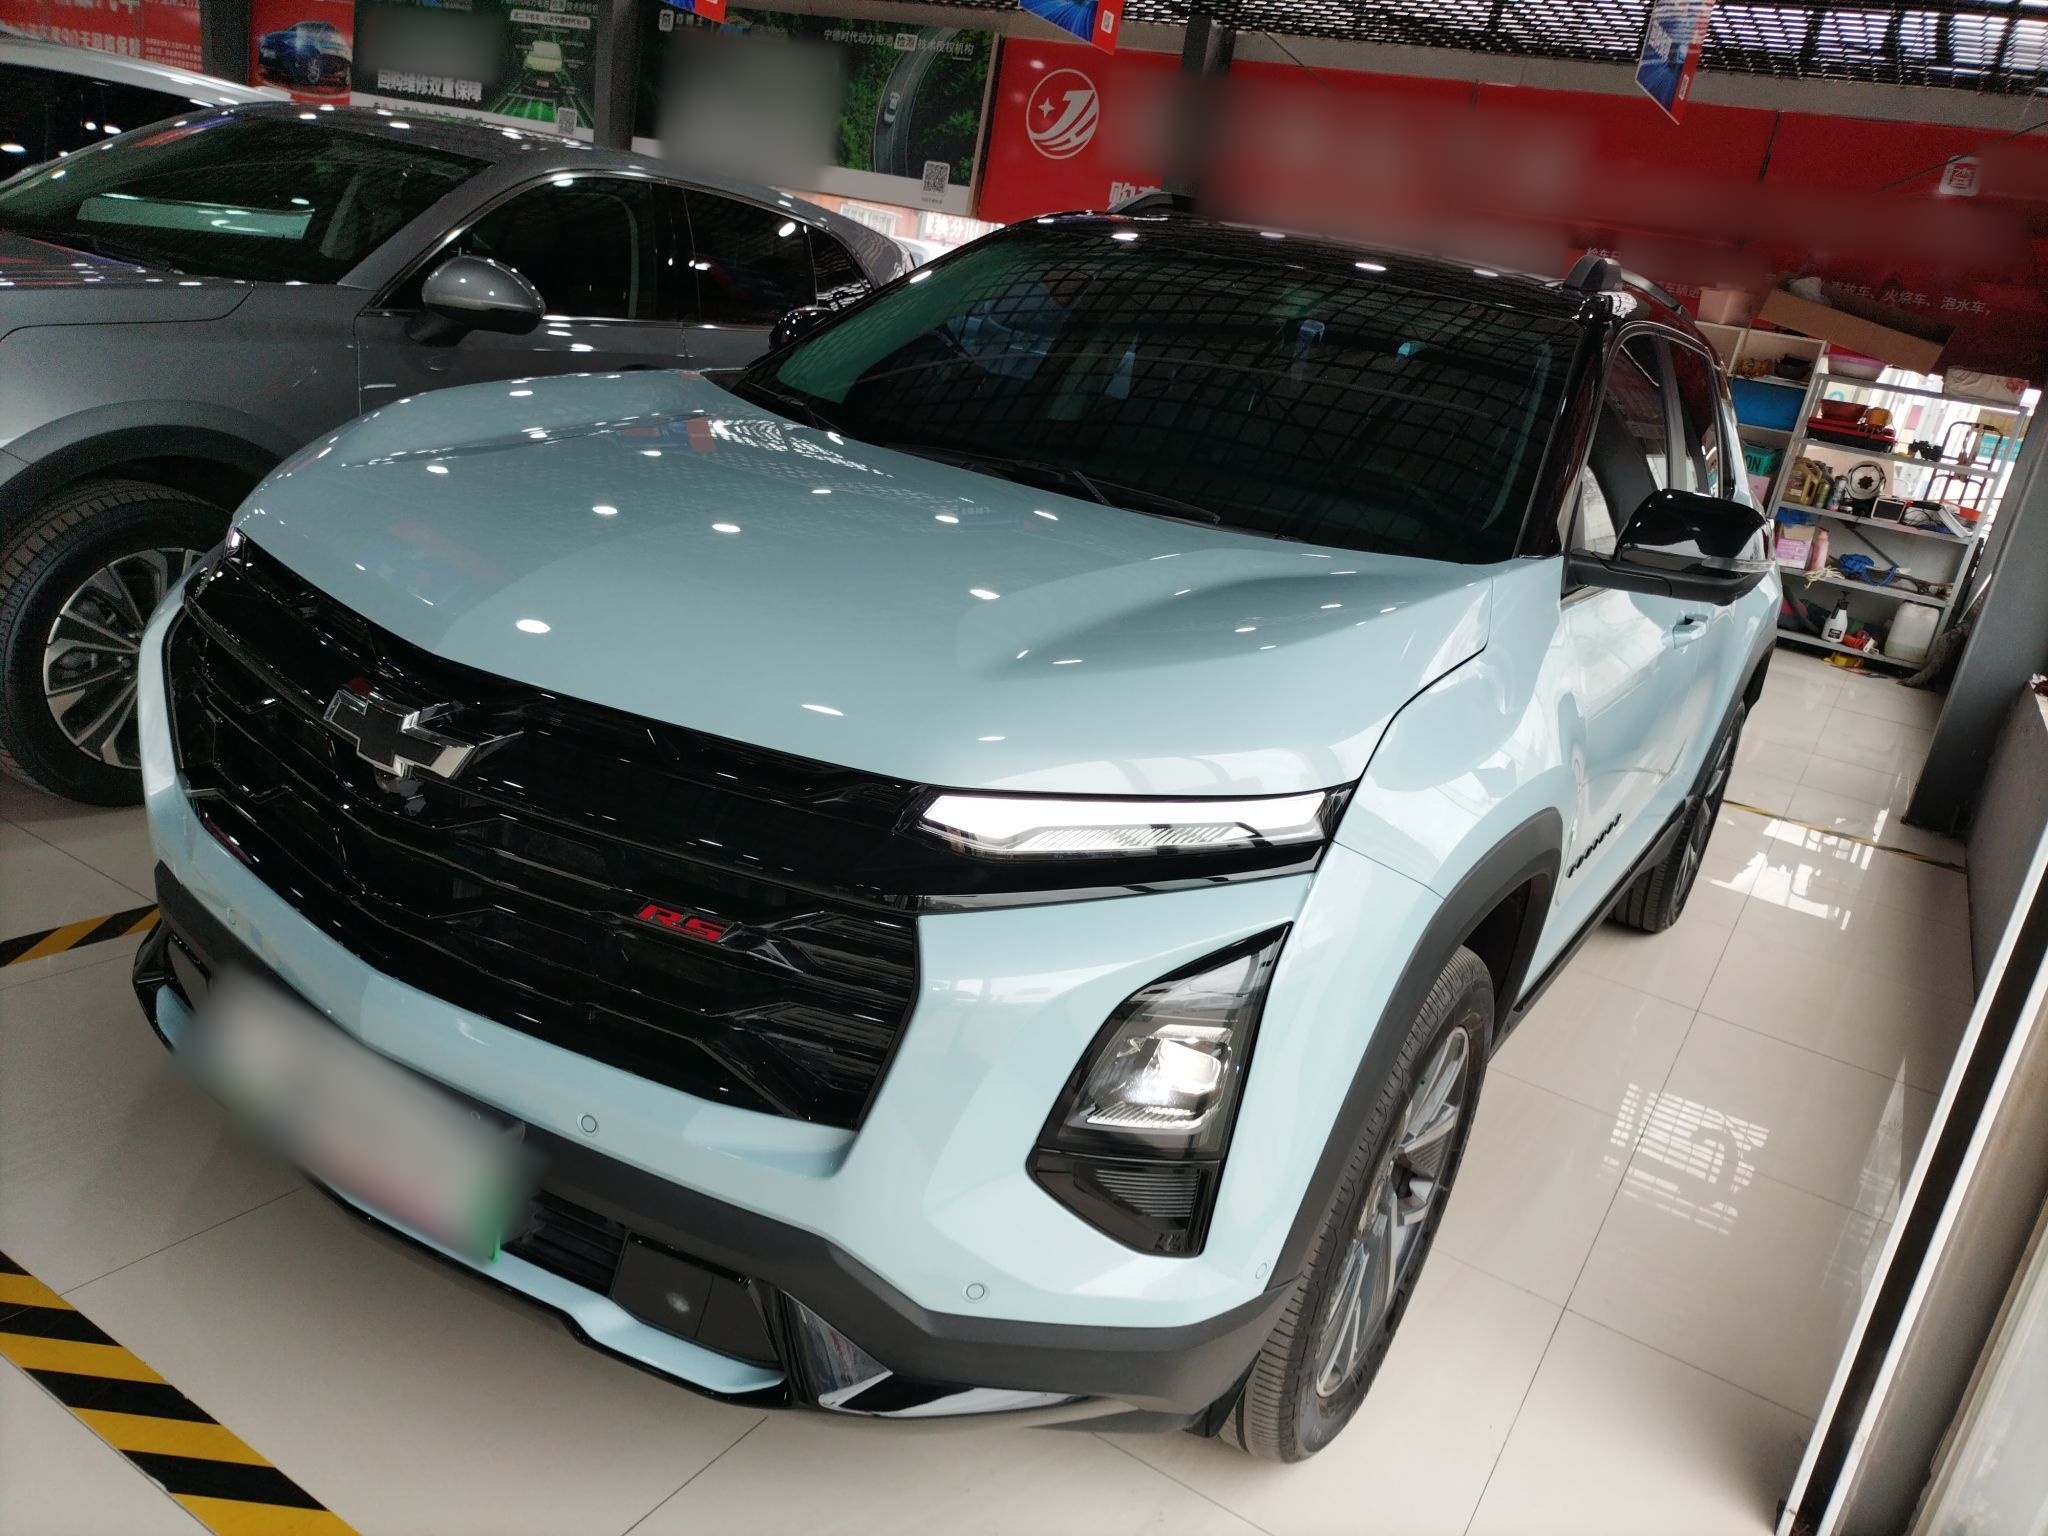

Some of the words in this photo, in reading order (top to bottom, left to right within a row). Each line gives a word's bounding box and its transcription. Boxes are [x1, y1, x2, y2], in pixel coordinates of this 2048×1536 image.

[378, 68, 482, 103] 回购维修双重保障
[638, 904, 729, 941] RS
